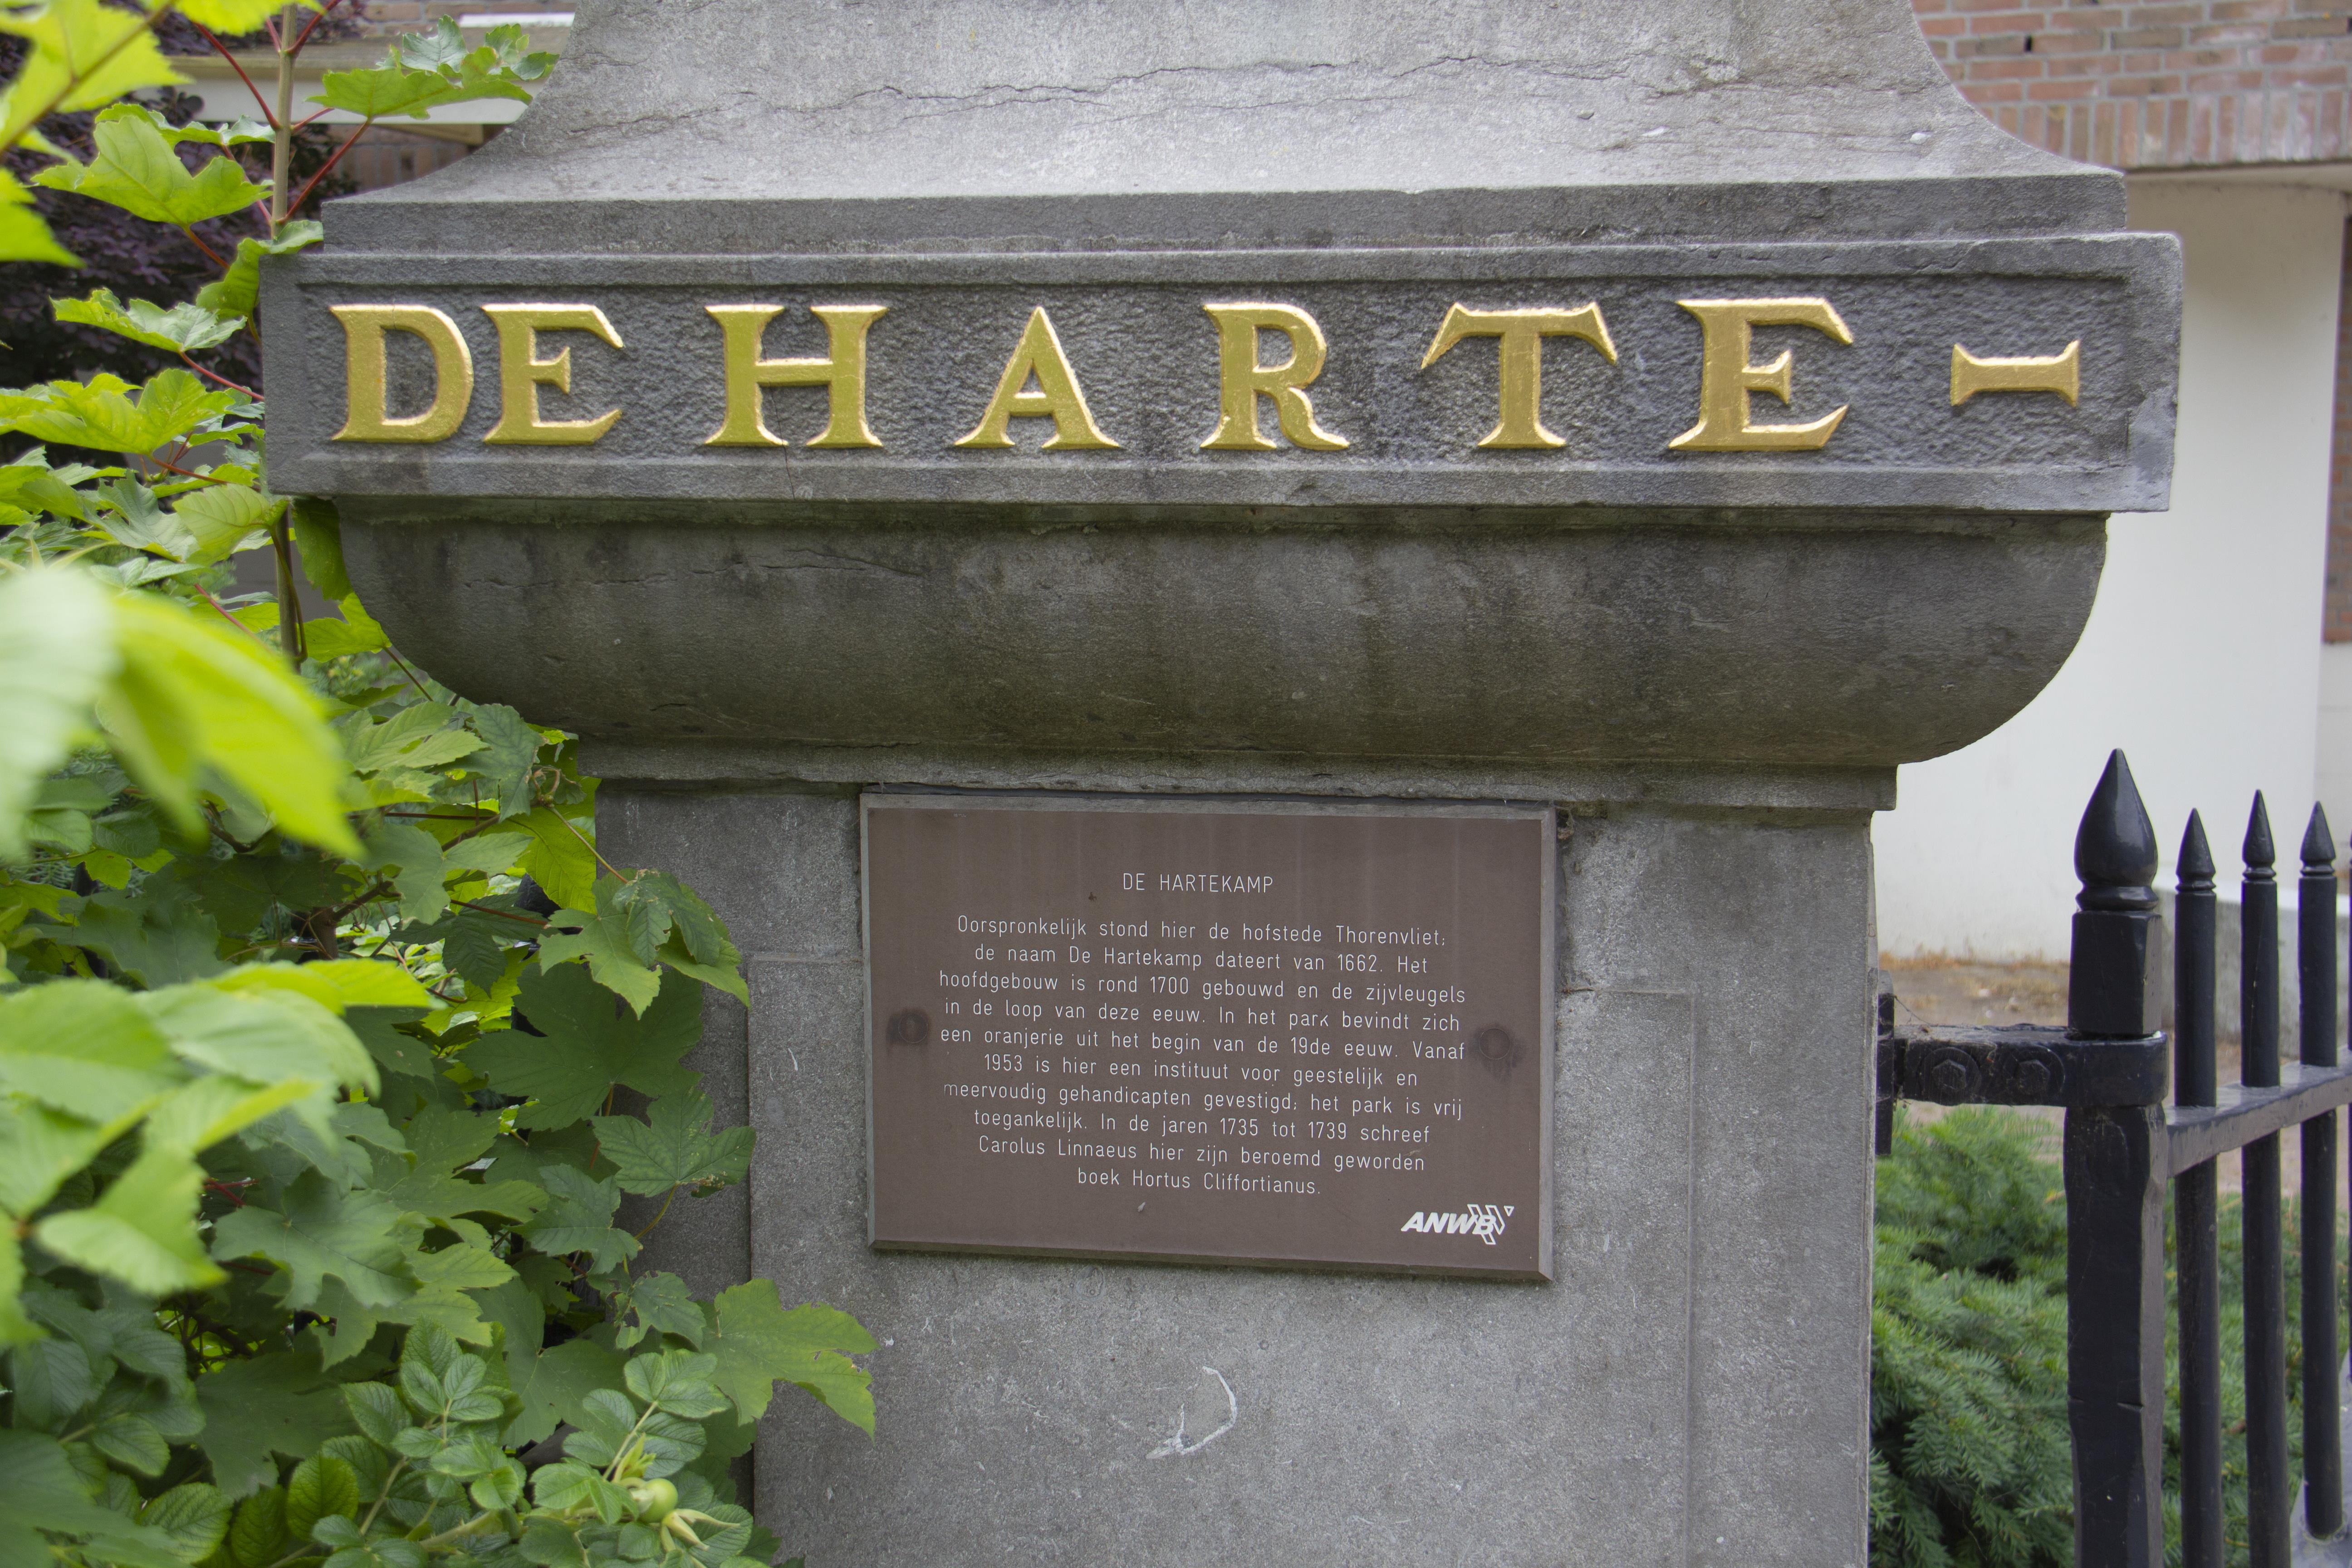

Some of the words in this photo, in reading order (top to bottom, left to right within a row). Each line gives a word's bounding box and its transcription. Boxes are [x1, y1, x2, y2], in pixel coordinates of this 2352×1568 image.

[329, 303, 624, 444] DE
[1123, 872, 1145, 891] DE
[1160, 873, 1273, 893] HARTEKAMP
[958, 915, 1087, 940] Oorspronkelijk
[1099, 920, 1148, 937] stond
[1161, 921, 1196, 939] hier
[1209, 922, 1229, 940] de
[1243, 922, 1322, 942] hofstede
[975, 943, 995, 961] de
[1008, 948, 1056, 962] naam
[1069, 946, 1091, 964] De
[1104, 946, 1202, 971] Hartekamp
[1215, 950, 1280, 969] dateert
[1293, 957, 1324, 970] van
[1337, 953, 1383, 972] 1662.
[1397, 955, 1427, 974] Het
[939, 970, 1058, 993] hoofdgebouw
[1071, 978, 1085, 991] is
[1098, 975, 1137, 993] rond
[1150, 976, 1189, 995] 1700
[1202, 978, 1284, 1000] gebouwd
[1298, 985, 1318, 999] en
[1332, 982, 1352, 1000] de
[1366, 984, 1465, 1008] zijvleugels
[945, 1001, 960, 1014] in
[973, 998, 992, 1016] de
[1005, 999, 1042, 1022] loop
[1054, 1005, 1085, 1019] van
[1098, 1002, 1139, 1021] deze
[1152, 1008, 1205, 1023] eeuw.
[1220, 1006, 1234, 1024] In
[1248, 1007, 1276, 1025] het
[1289, 1009, 1329, 1031] park
[1342, 1010, 1409, 1030] bevindt
[1422, 1013, 1460, 1031] zich
[941, 1029, 971, 1042] een
[984, 1030, 1063, 1049] oranjerie
[1077, 1031, 1098, 1047] uit
[1111, 1030, 1139, 1049] het
[1152, 1032, 1200, 1055] begin
[1213, 1038, 1244, 1052] van
[1257, 1035, 1278, 1054] de
[1290, 1036, 1330, 1055] 19de
[1344, 1043, 1398, 1057] eeuw.
[1412, 1040, 1465, 1060] Vanaf
[984, 1054, 1023, 1072] 1953
[1036, 1060, 1050, 1073] is
[1063, 1056, 1097, 1074] hier
[1109, 1063, 1141, 1076] een
[1154, 1062, 1228, 1080] instituut
[1241, 1067, 1280, 1082] voor
[1294, 1067, 1383, 1090] geestelijk
[1396, 1073, 1417, 1086] en
[943, 1082, 1046, 1105] meervoudig
[1059, 1084, 1191, 1109] gehandicapten
[1311, 1093, 1339, 1112] het
[1352, 1096, 1392, 1117] park
[1406, 1101, 1420, 1115] is
[1433, 1098, 1461, 1121] vrij
[974, 1109, 1087, 1133] toegankelijk.
[1101, 1112, 1116, 1130] In
[1129, 1114, 1149, 1132] de
[1161, 1120, 1207, 1137] jaren
[1220, 1117, 1259, 1137] 1735
[1272, 1121, 1296, 1138] tot
[1308, 1121, 1347, 1140] 1739
[1360, 1124, 1430, 1143] schreef
[979, 1135, 1045, 1155] Carolus
[1058, 1138, 1137, 1159] Linnaeus
[1150, 1142, 1184, 1161] hier
[1196, 1149, 1228, 1167] zijn
[1241, 1146, 1320, 1167] beroemd
[1334, 1150, 1424, 1173] geworden
[1078, 1166, 1120, 1186] boek
[1132, 1169, 1191, 1189] Hortus
[1204, 1172, 1320, 1195] Cliffortianus.
[1401, 1211, 1497, 1235] ANWB
